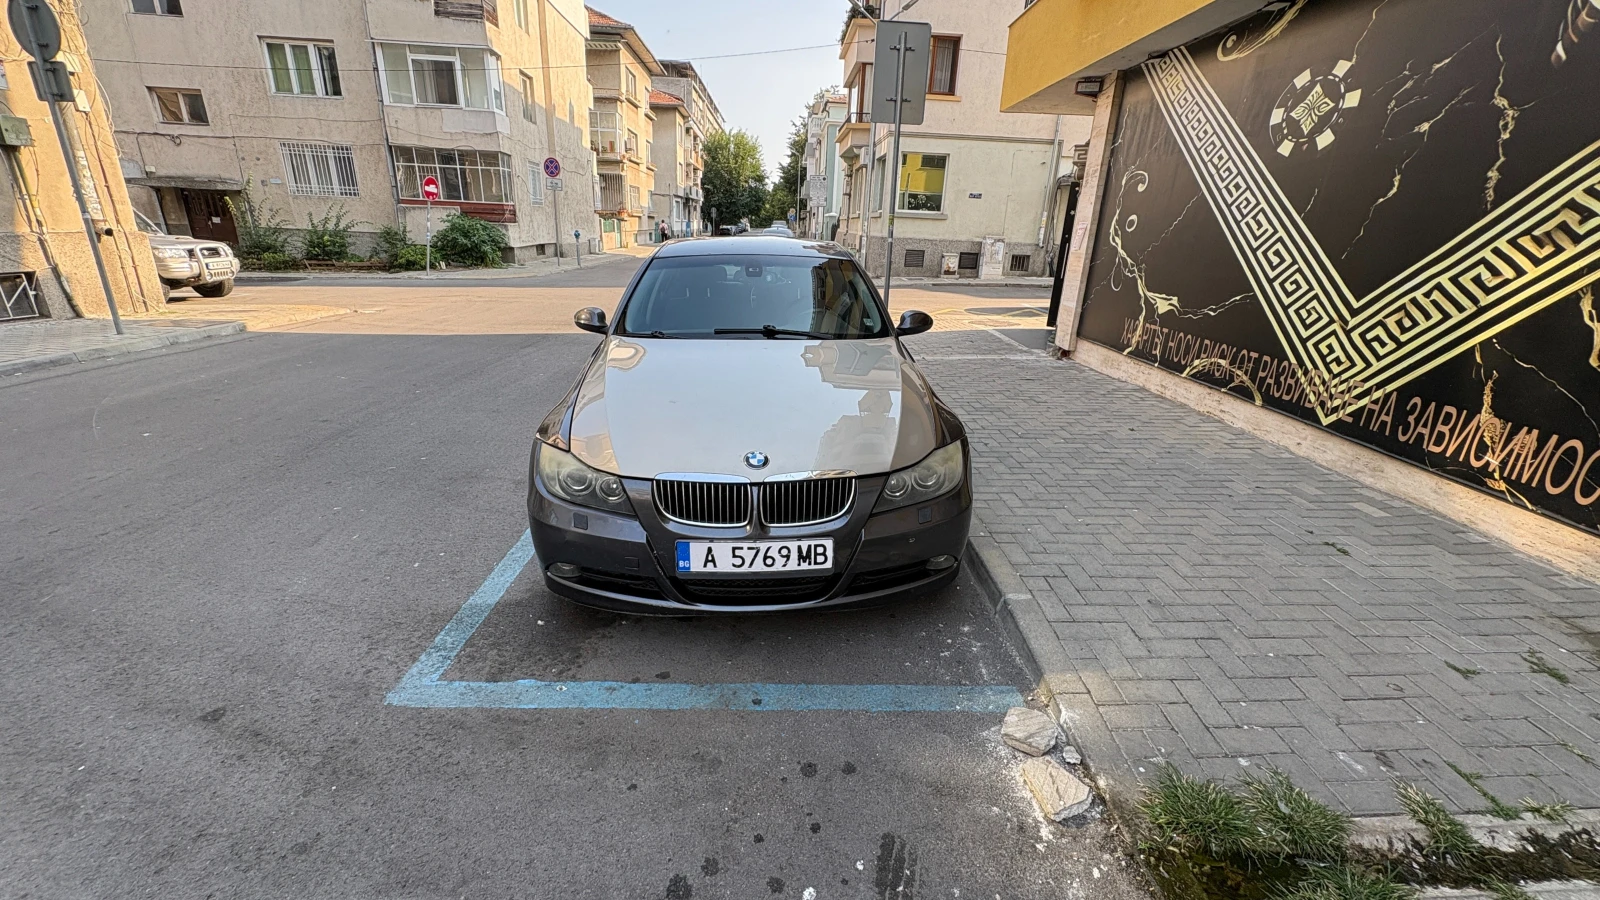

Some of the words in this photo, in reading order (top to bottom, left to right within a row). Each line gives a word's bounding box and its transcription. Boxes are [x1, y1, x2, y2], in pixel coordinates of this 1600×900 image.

[1120, 317, 1169, 357] ХАЗАРТЪТ
[1165, 329, 1201, 366] НОСИ
[1199, 339, 1236, 380] РИСК
[1233, 349, 1259, 384] ОТ
[1254, 355, 1365, 423] РАЗВИВАНЕ
[1360, 386, 1398, 436] НА
[679, 560, 690, 568] BG
[703, 546, 717, 568] A
[731, 545, 791, 568] 5769
[797, 543, 828, 567] MB
